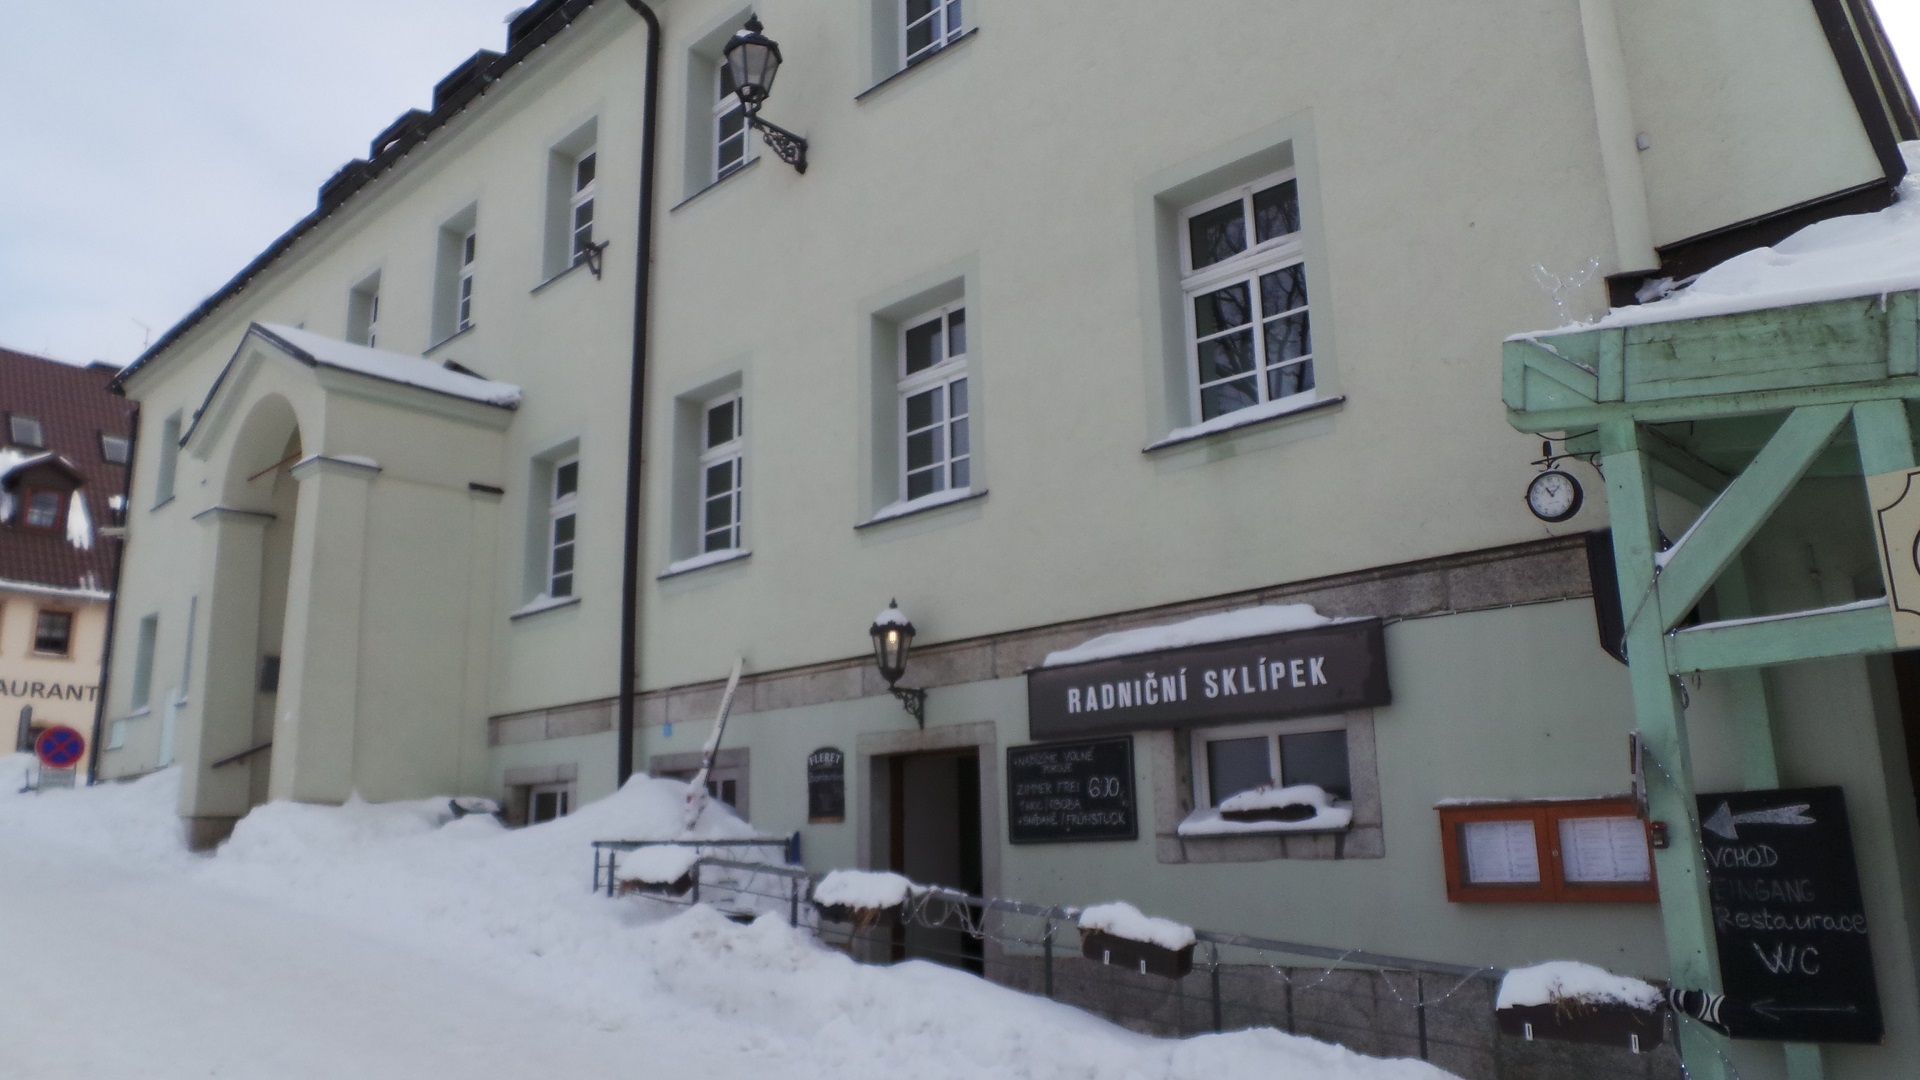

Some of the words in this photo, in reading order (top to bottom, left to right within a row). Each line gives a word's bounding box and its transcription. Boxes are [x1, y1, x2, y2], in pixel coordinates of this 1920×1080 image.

[1068, 668, 1187, 714] RADNIČNÍ
[1204, 656, 1329, 699] SKLÍPEK
[1016, 783, 1052, 795] ZIMMER
[1057, 780, 1081, 793] FREI
[1706, 845, 1778, 868] VCHOD
[1713, 878, 1816, 903] EINGANG
[1715, 907, 1868, 934] Restaurace
[1752, 942, 1820, 975] WC
